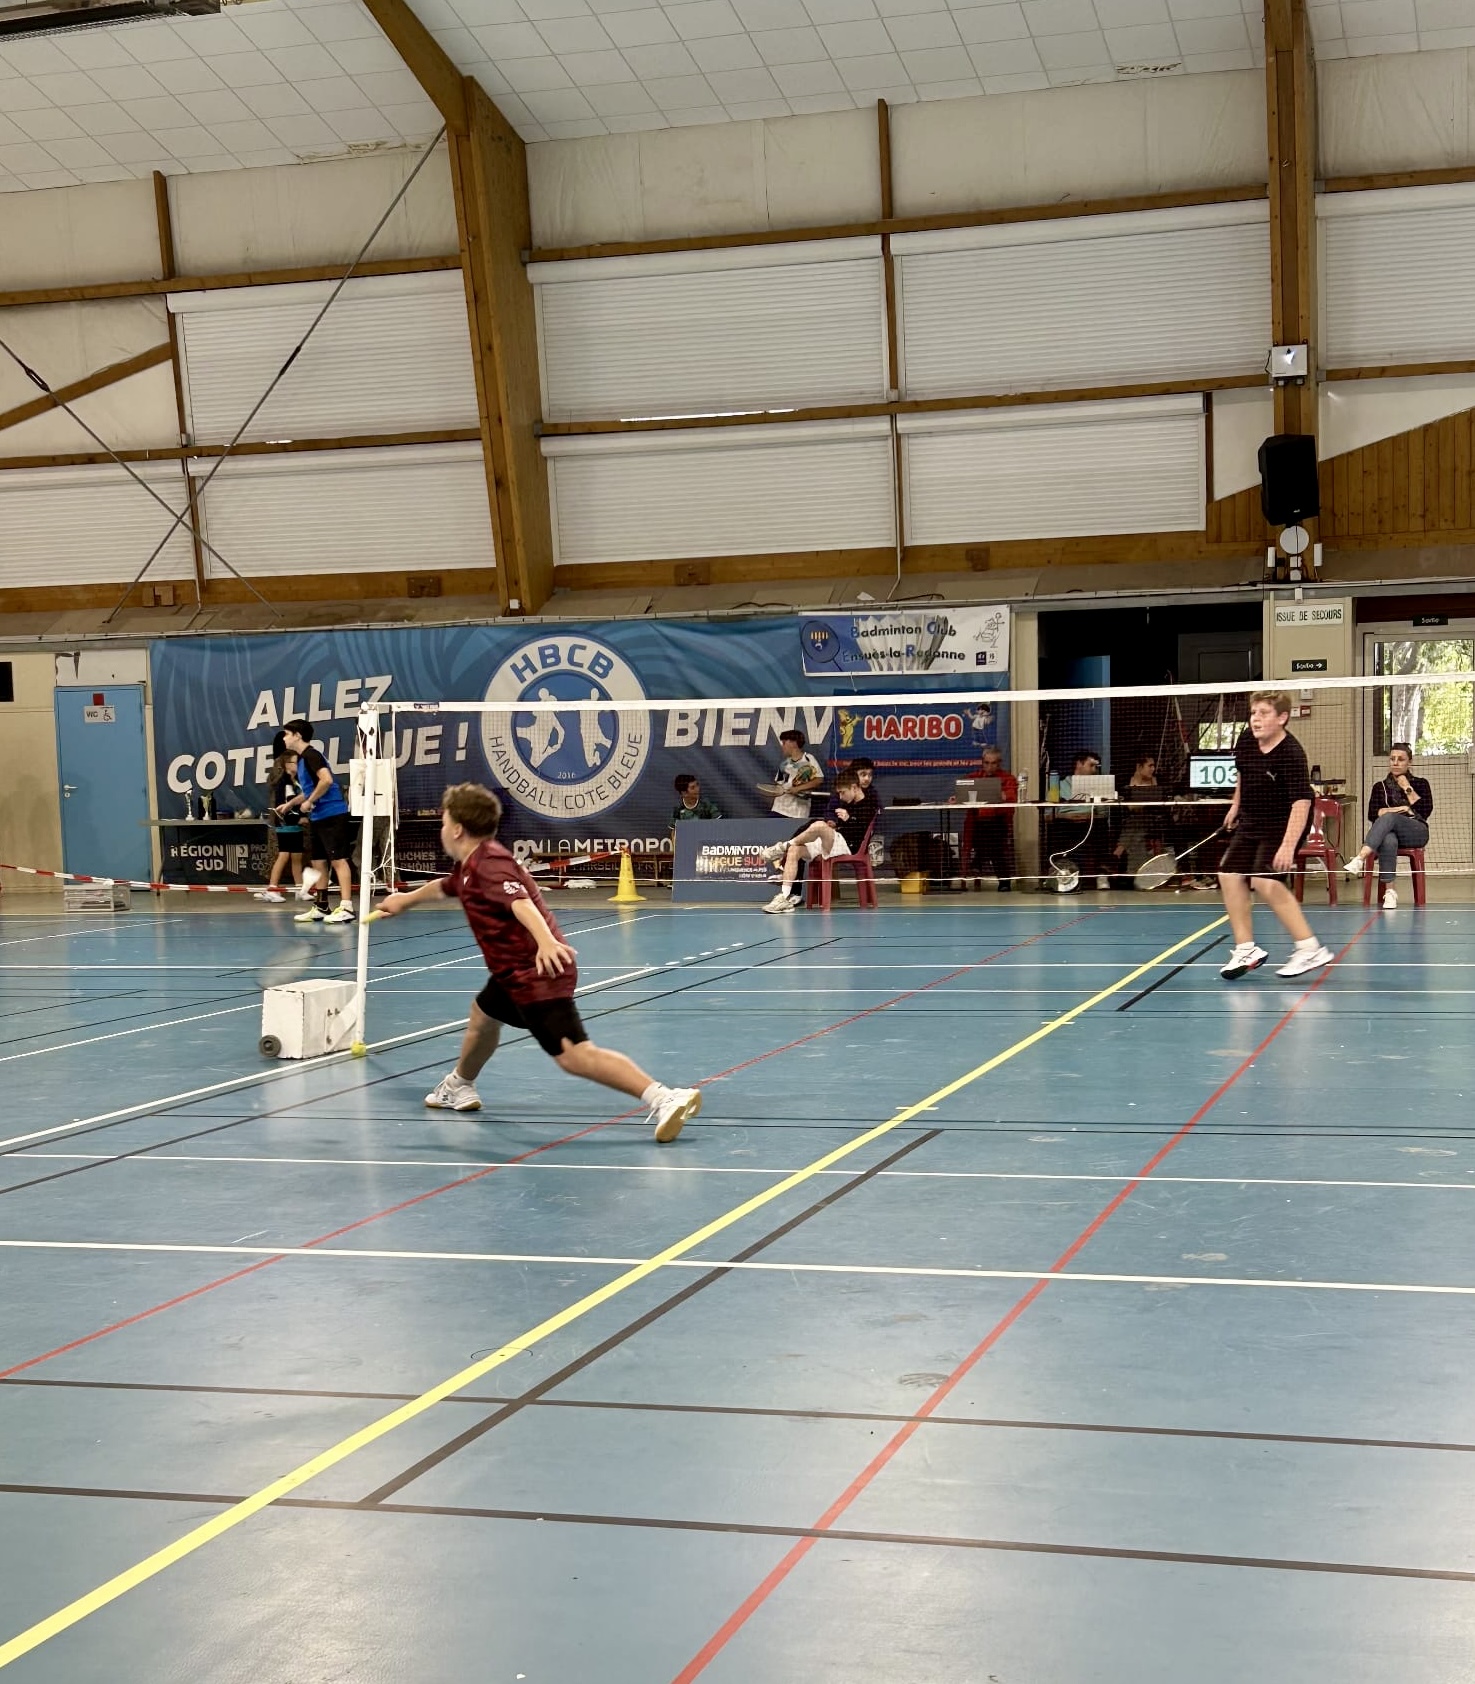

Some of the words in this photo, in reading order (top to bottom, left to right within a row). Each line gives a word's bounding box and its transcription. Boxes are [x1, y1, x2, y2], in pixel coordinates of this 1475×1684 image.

[1276, 611, 1295, 622] ISSUE
[1299, 610, 1308, 621] DE
[1312, 608, 1342, 620] SECOURS
[851, 623, 922, 639] Badminton
[927, 620, 957, 637] Club
[510, 643, 614, 684] HBCB
[247, 675, 393, 730] ALLEZ
[864, 714, 963, 741] HARIBO
[489, 736, 557, 809] HANDBALL
[564, 785, 610, 810] COTE
[607, 733, 643, 791] BLEUE
[557, 771, 576, 779] 2016
[1199, 765, 1238, 784] 103
[196, 859, 224, 871] SUD
